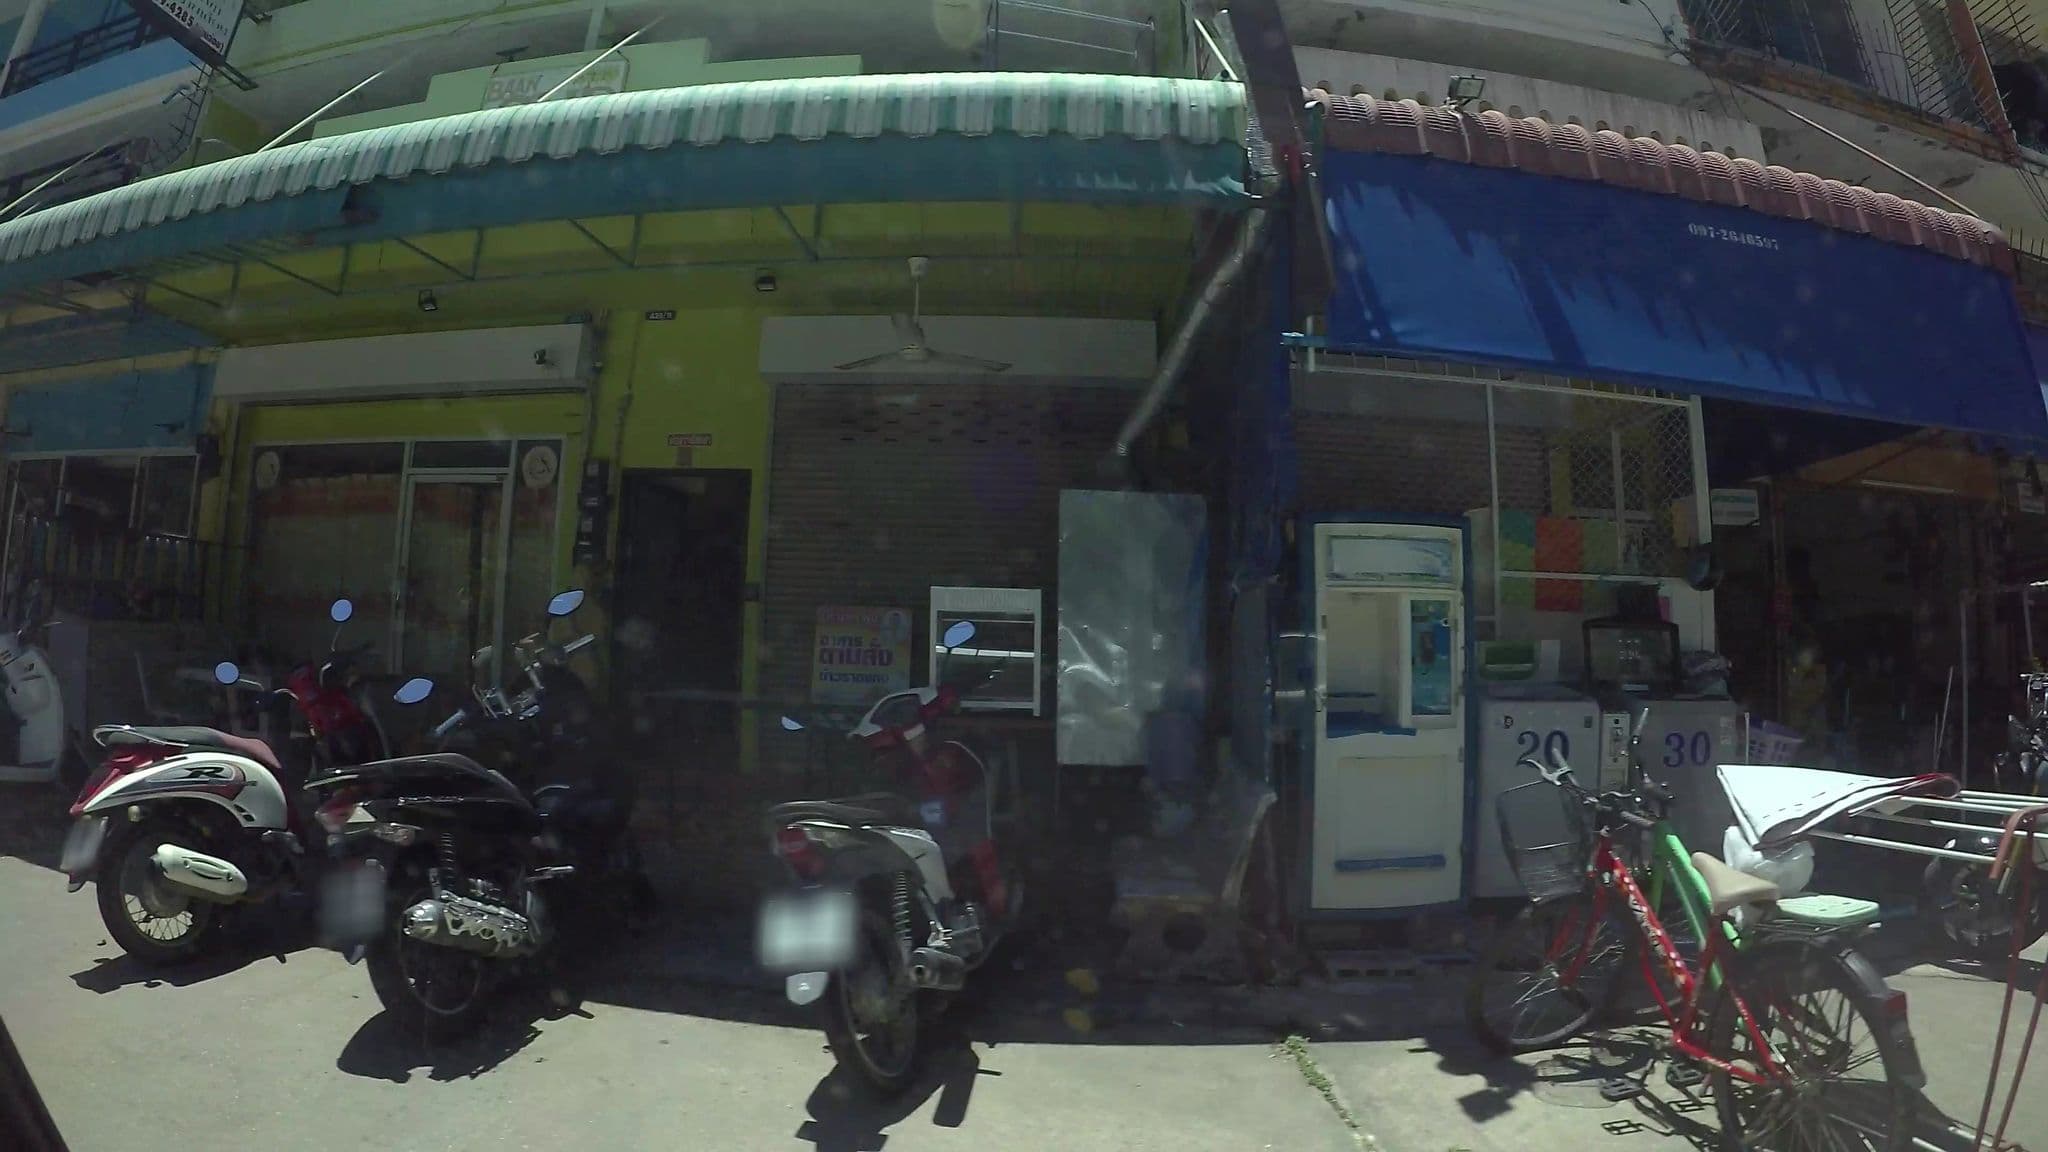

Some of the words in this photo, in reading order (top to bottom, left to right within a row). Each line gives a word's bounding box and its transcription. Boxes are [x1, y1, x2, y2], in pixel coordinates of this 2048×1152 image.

[820, 638, 895, 666] ตามสั่ง
[1516, 730, 1570, 768] 20
[1663, 731, 1711, 768] 30
